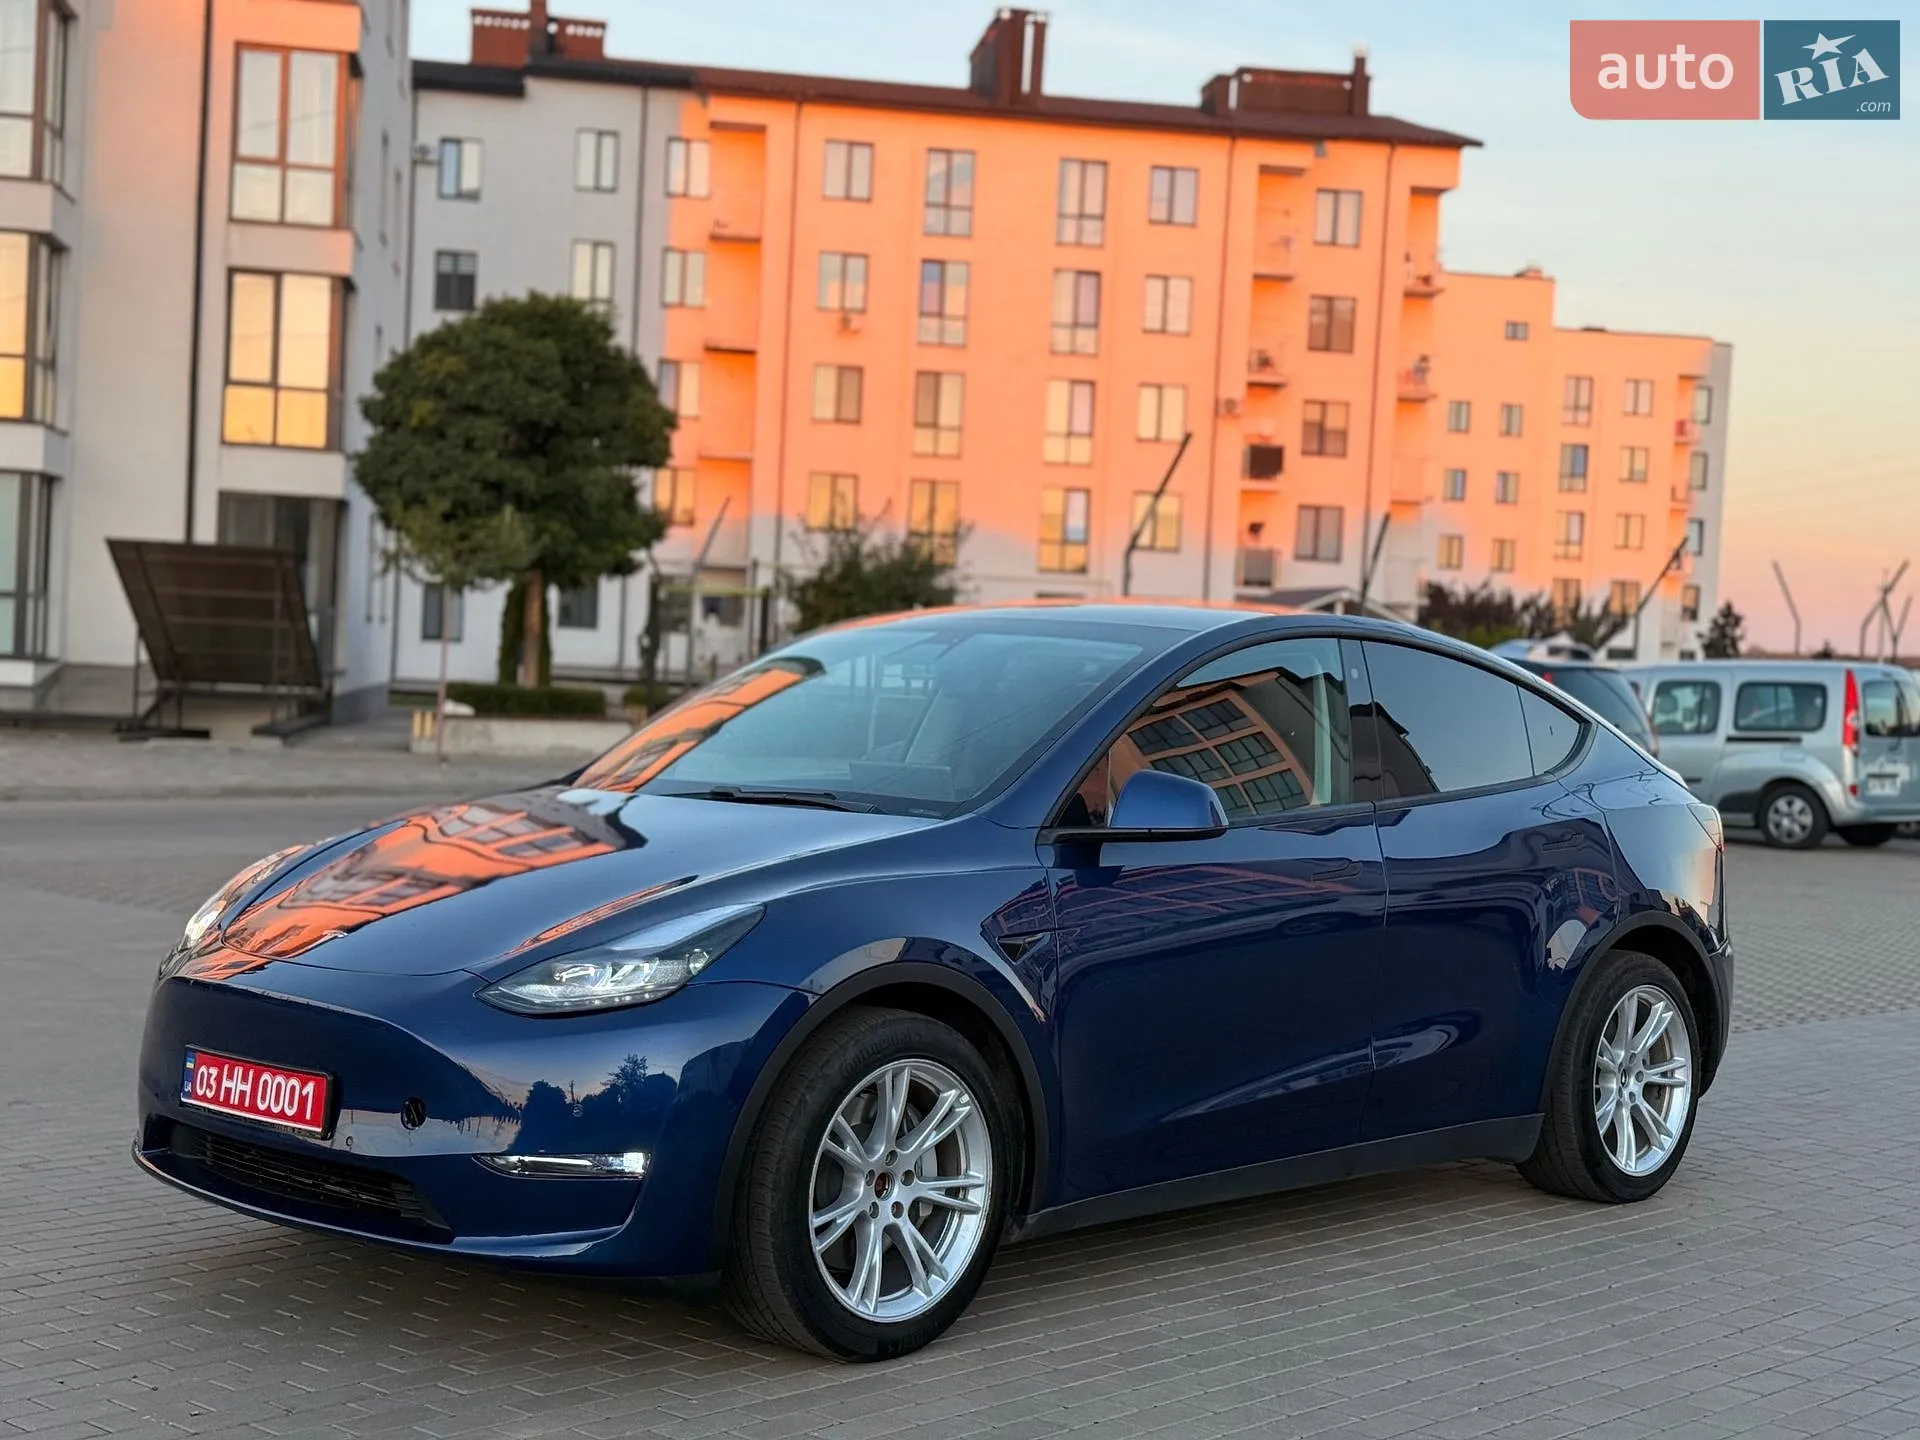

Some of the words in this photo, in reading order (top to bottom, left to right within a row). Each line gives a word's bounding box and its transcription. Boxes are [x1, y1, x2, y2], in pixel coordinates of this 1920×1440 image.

[183, 1080, 193, 1093] UA
[195, 1065, 219, 1099] 03
[219, 1063, 255, 1108] HH
[256, 1071, 317, 1121] 0001
